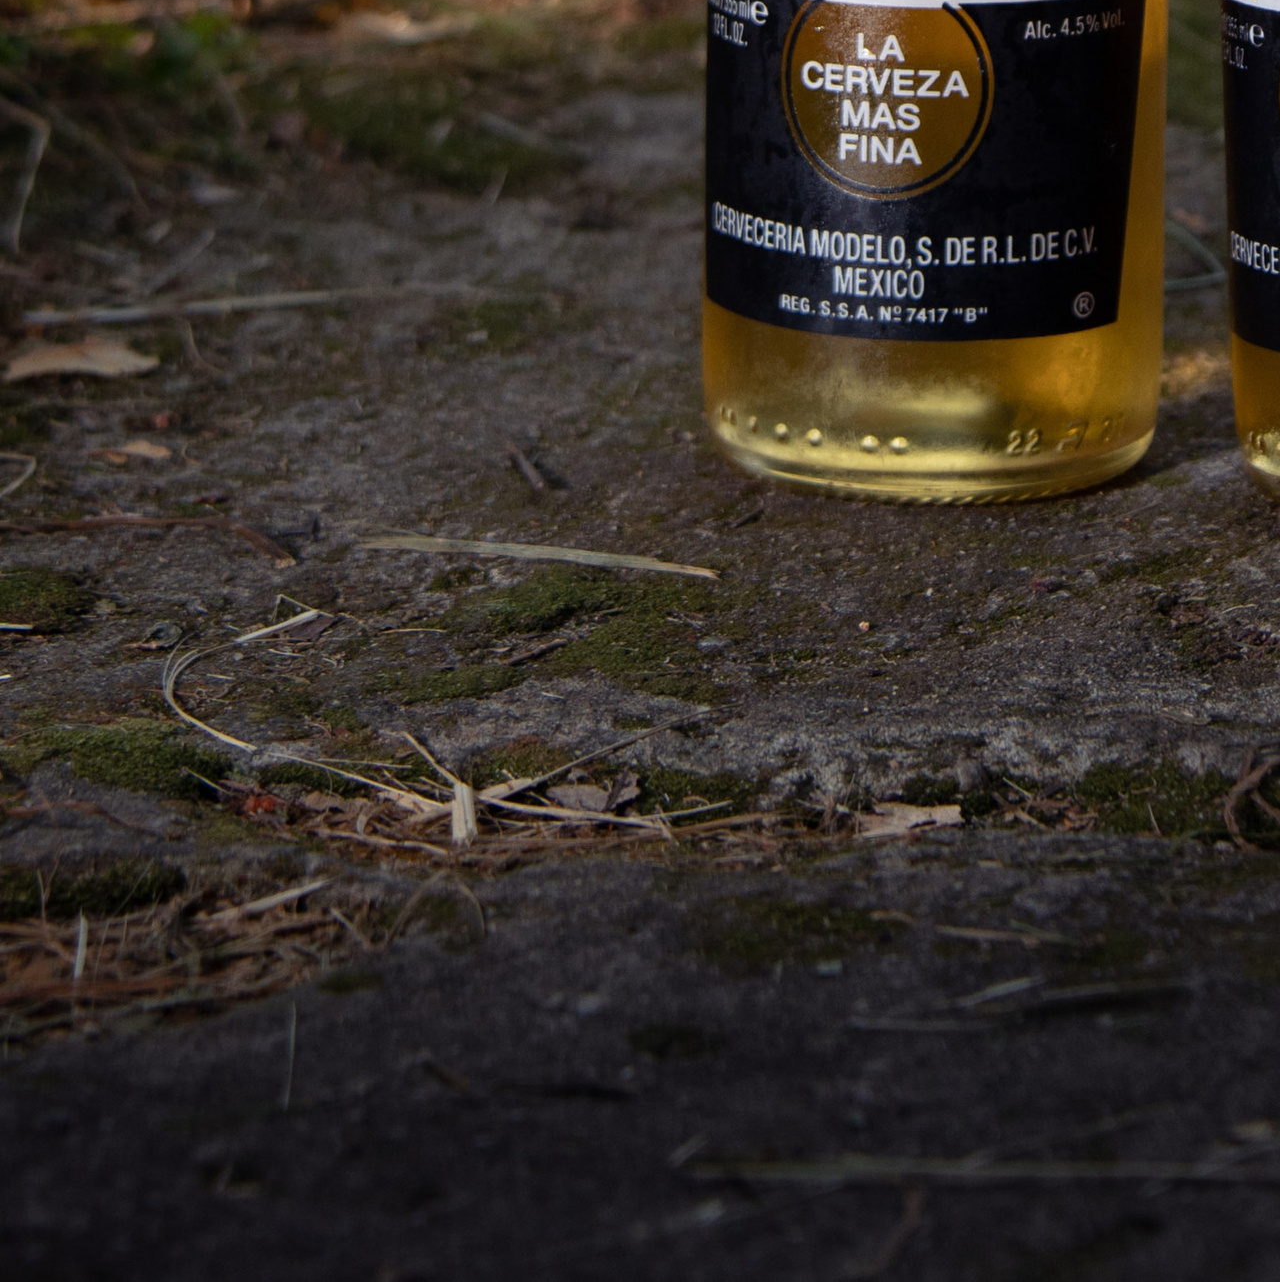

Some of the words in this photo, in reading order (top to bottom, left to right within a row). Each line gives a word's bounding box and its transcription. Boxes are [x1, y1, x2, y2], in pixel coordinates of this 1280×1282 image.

[1024, 18, 1056, 40] Alc.
[857, 33, 905, 62] LA
[801, 61, 969, 98] CERVEZA
[841, 101, 921, 132] MAS
[839, 133, 922, 166] FINA
[712, 201, 807, 256] CERVECERIA
[809, 227, 912, 269] MODELO,
[916, 236, 940, 265] S.
[944, 236, 976, 266] DE
[1030, 231, 1059, 263] DE
[1063, 226, 1098, 257] C.V.
[833, 265, 926, 300] MEXICO
[779, 293, 816, 315] REG.
[906, 307, 948, 324] 7417
